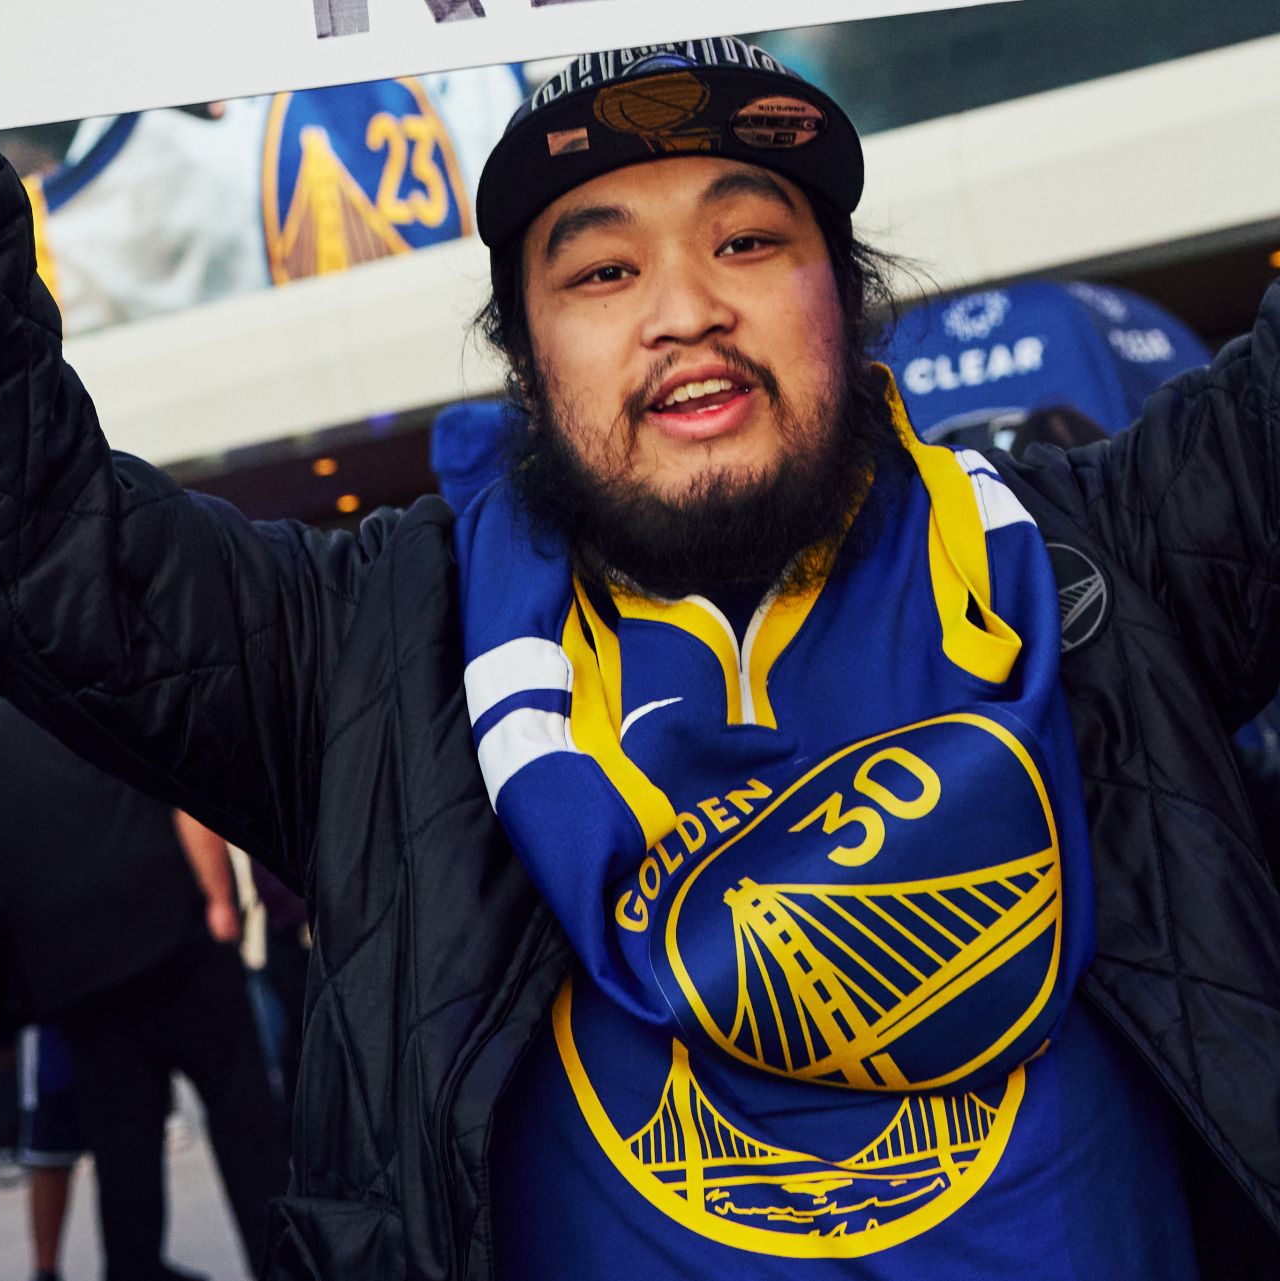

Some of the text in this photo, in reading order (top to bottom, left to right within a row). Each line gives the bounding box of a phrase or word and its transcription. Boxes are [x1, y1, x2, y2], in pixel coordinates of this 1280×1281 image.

[365, 111, 449, 228] 23
[904, 336, 1044, 394] CLEAR
[614, 778, 773, 934] GOLDEN
[788, 747, 941, 867] 30
